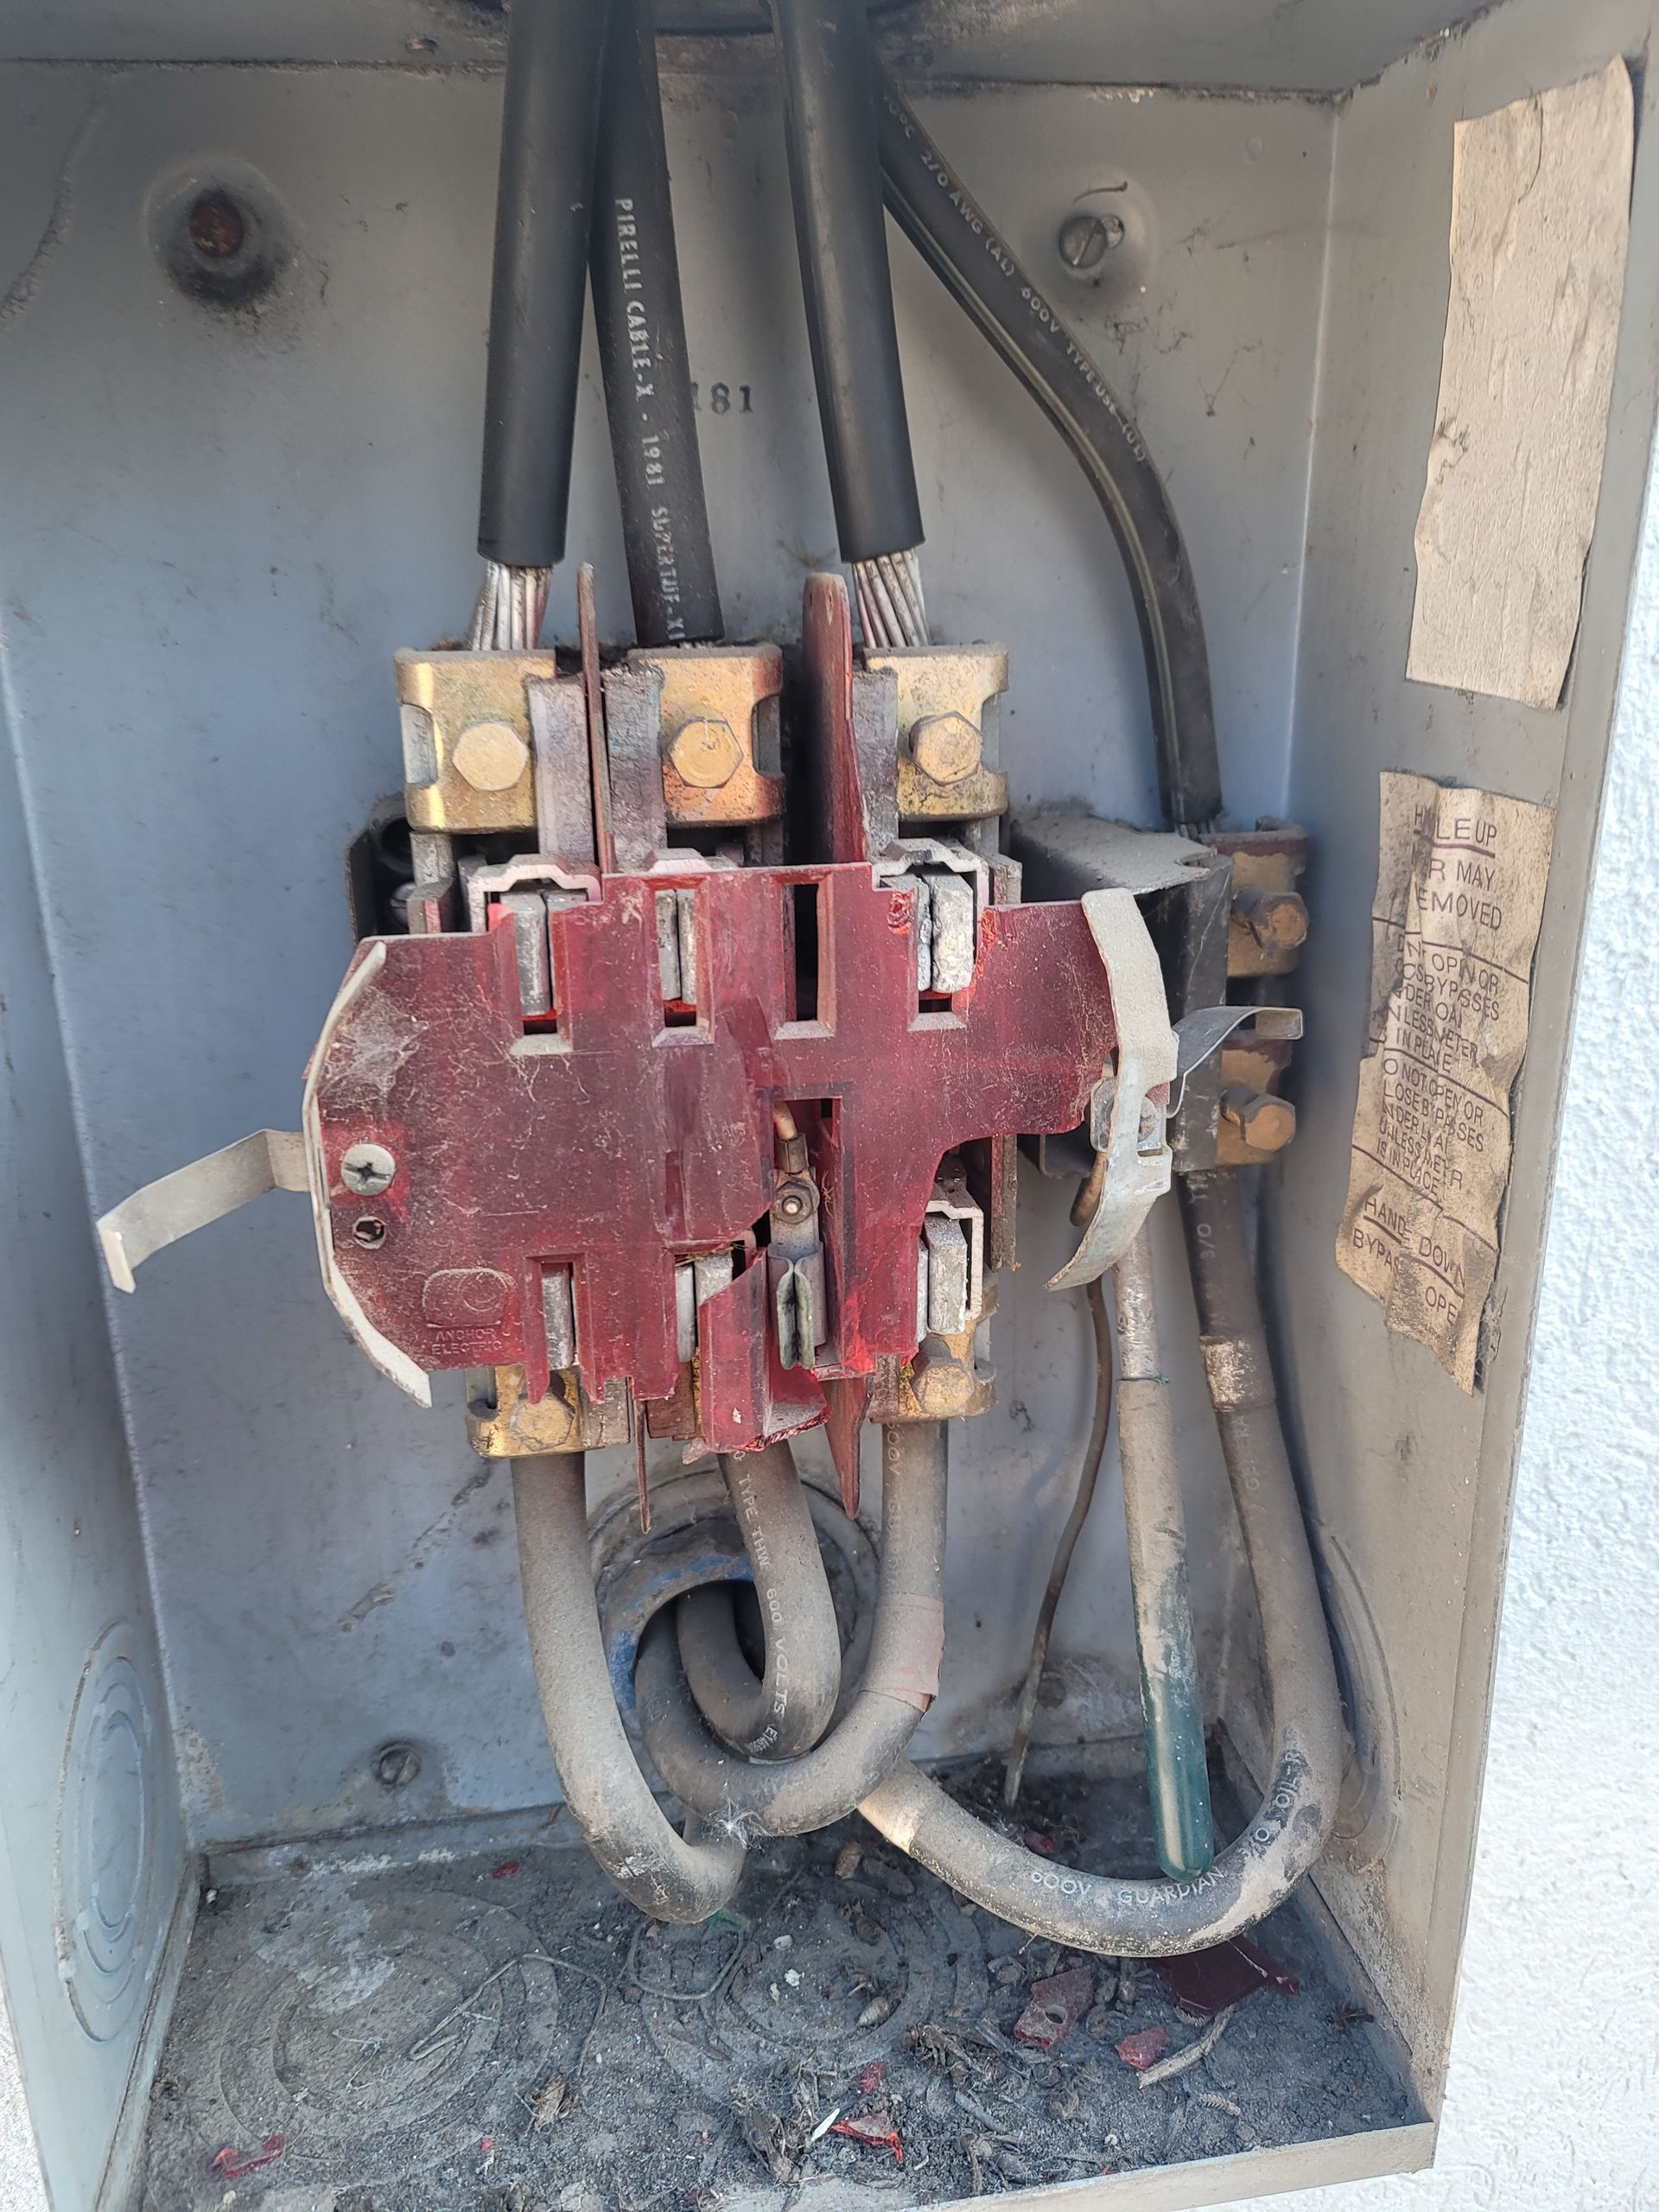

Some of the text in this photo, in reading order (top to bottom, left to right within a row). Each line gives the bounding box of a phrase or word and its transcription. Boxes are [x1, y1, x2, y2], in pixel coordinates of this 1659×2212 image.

[920, 150, 949, 188] 2/0
[950, 189, 984, 235] AWG
[985, 237, 1015, 277] (AL)
[1020, 286, 1061, 334] 600V
[1066, 341, 1097, 385] TYPE
[1096, 385, 1116, 415] USE
[614, 197, 643, 295] PIRELLI
[642, 434, 666, 489] 1981
[1475, 819, 1497, 847] UP
[1456, 859, 1497, 892] MAY
[1415, 882, 1502, 931] EMOVED
[1432, 953, 1499, 995] OPN OR
[1425, 974, 1499, 1021] BYPSSES
[1396, 1027, 1411, 1051] IN
[1384, 1080, 1421, 1113] LOSE
[1402, 1063, 1427, 1091] NOT
[1429, 1079, 1463, 1111] OPEN
[1464, 1101, 1484, 1127] OR
[1379, 1116, 1421, 1160] UNLESS
[1377, 1138, 1440, 1197] IS IN PLACE
[1364, 1198, 1414, 1242] HANDE
[432, 1340, 502, 1356] ELECTRIC
[435, 1327, 498, 1343] ANCHOR
[739, 1473, 760, 1525] TYPE
[751, 1525, 771, 1571] THW
[766, 1587, 782, 1624] 600
[773, 1637, 788, 1718] VOLTS
[1031, 1871, 1093, 1897] 600V
[1117, 1866, 1225, 1907] GUARDIAN
